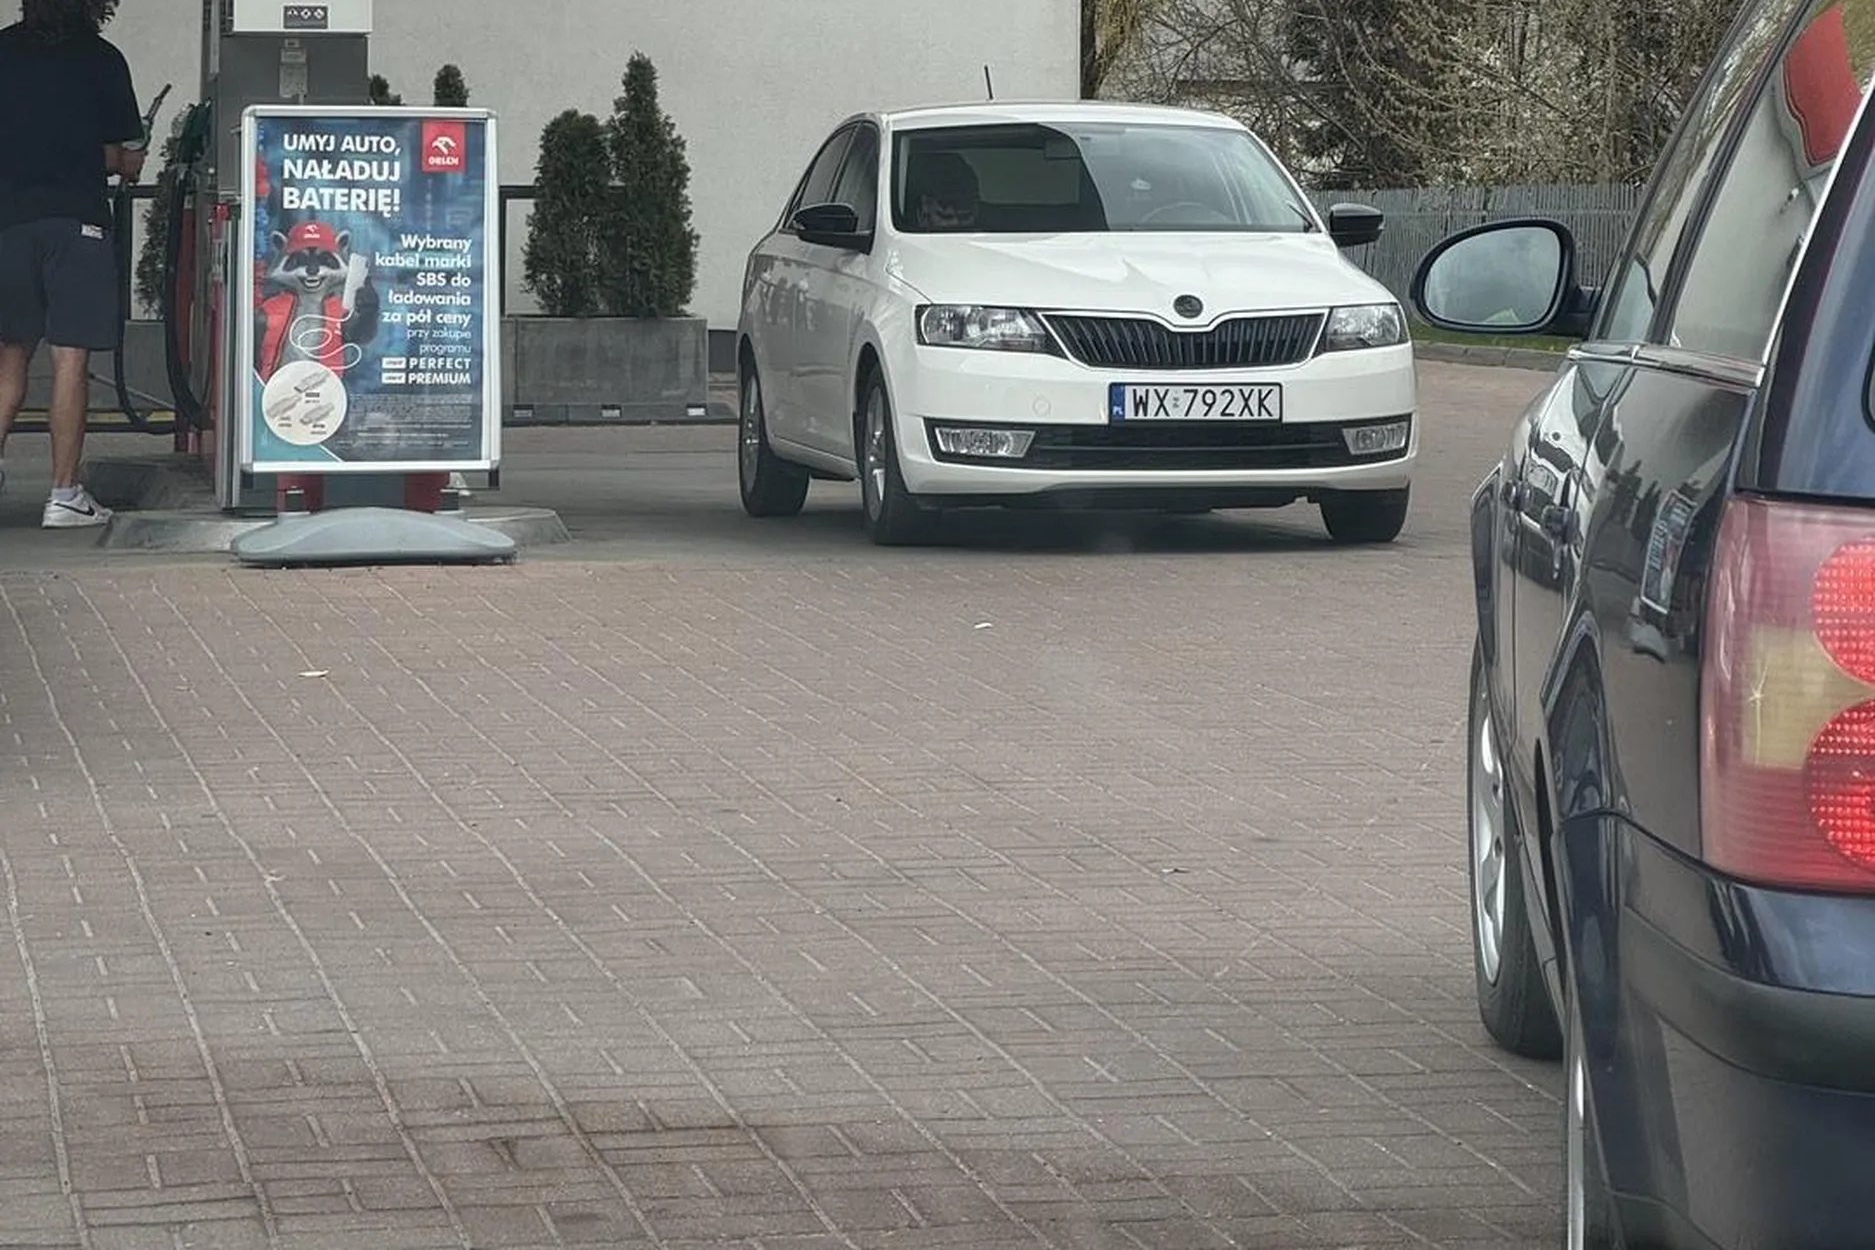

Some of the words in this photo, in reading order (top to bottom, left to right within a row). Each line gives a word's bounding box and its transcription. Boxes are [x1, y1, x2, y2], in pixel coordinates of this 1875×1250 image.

[283, 133, 336, 151] UMYJ
[341, 135, 402, 156] AUTO,
[428, 156, 460, 166] ORLEN
[283, 158, 401, 181] NAŁADUJ
[283, 186, 400, 218] BATERIĘ!
[400, 233, 472, 253] Wybrany
[375, 252, 420, 268] kabel
[424, 254, 472, 268] marki
[416, 272, 447, 286] SBS
[450, 272, 471, 287] do
[388, 290, 471, 305] ładowania
[381, 311, 401, 322] za
[406, 309, 431, 326] pół
[436, 312, 472, 330] ceny
[407, 329, 430, 340] przy
[432, 327, 472, 341] zakupie
[419, 343, 472, 355] programu
[409, 357, 472, 369] PERFECT
[408, 372, 472, 384] PREMIUM
[1132, 388, 1170, 418] WX
[1182, 388, 1274, 418] 792XK
